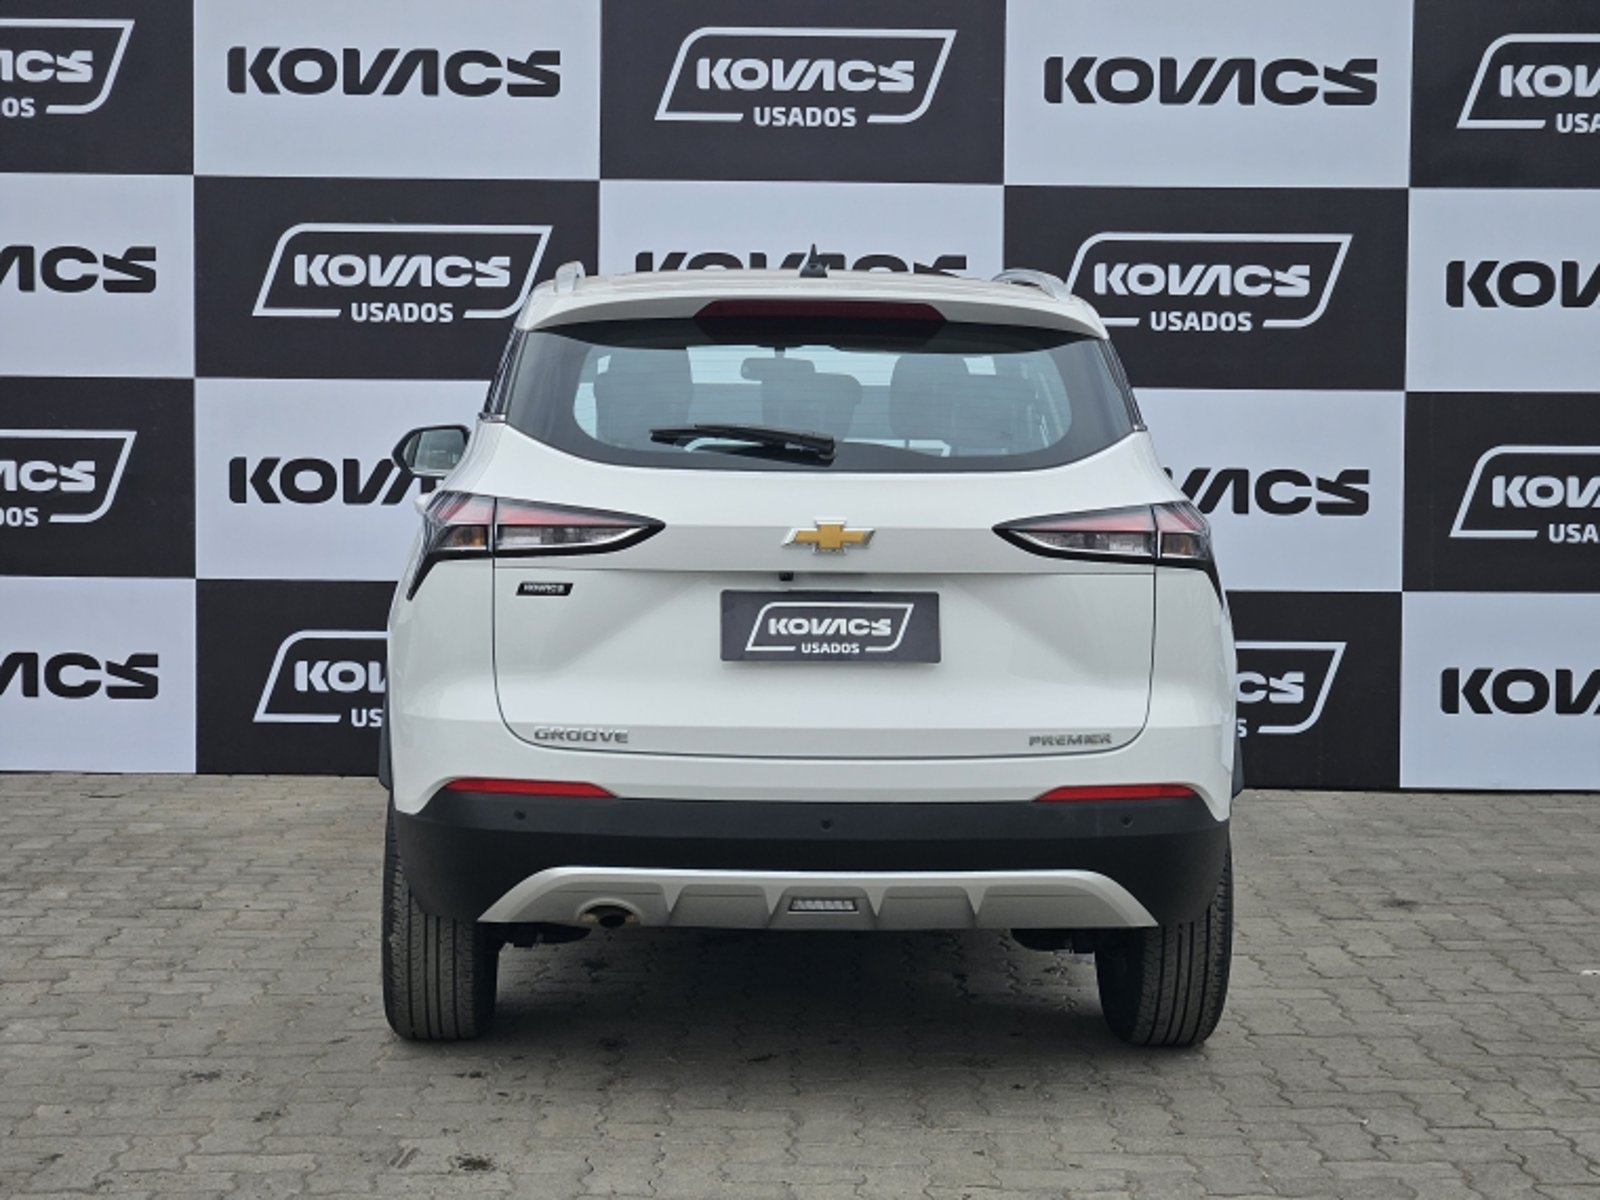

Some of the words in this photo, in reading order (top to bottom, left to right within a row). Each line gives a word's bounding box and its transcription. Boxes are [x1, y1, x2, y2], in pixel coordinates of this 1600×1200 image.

[228, 46, 561, 98] KOVACS
[696, 58, 915, 92] KOVACS
[1043, 56, 1378, 106] KOVACS
[753, 106, 857, 127] USADOS
[294, 254, 511, 288] KOVACS
[1093, 262, 1310, 297] KOVACS
[351, 302, 454, 323] USADOS
[1150, 311, 1253, 332] USADOS
[1492, 475, 1600, 508] KOV
[768, 618, 892, 636] KOVACS
[801, 642, 860, 653] USADOS
[1440, 667, 1600, 716] KOV
[534, 726, 629, 744] GROOVE
[1028, 732, 1112, 747] PREMIER
